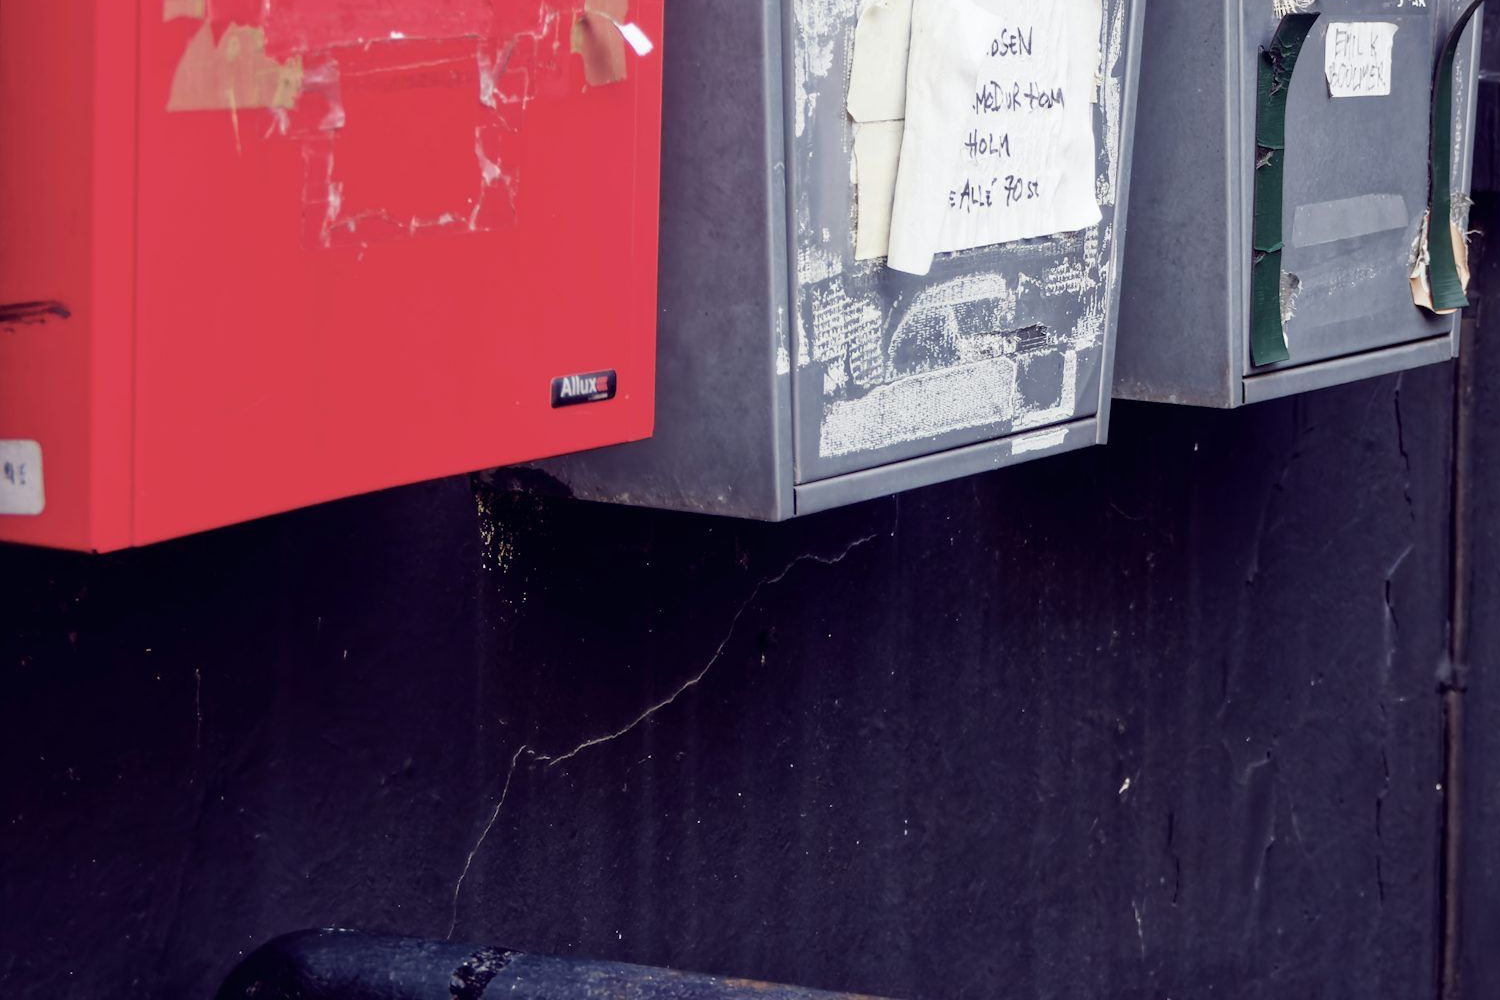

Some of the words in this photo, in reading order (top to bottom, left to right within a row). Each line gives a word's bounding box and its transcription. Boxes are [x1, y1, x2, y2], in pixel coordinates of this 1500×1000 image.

[964, 129, 1011, 159] HOLM
[1004, 174, 1024, 208] 70
[560, 375, 598, 398] Allux
